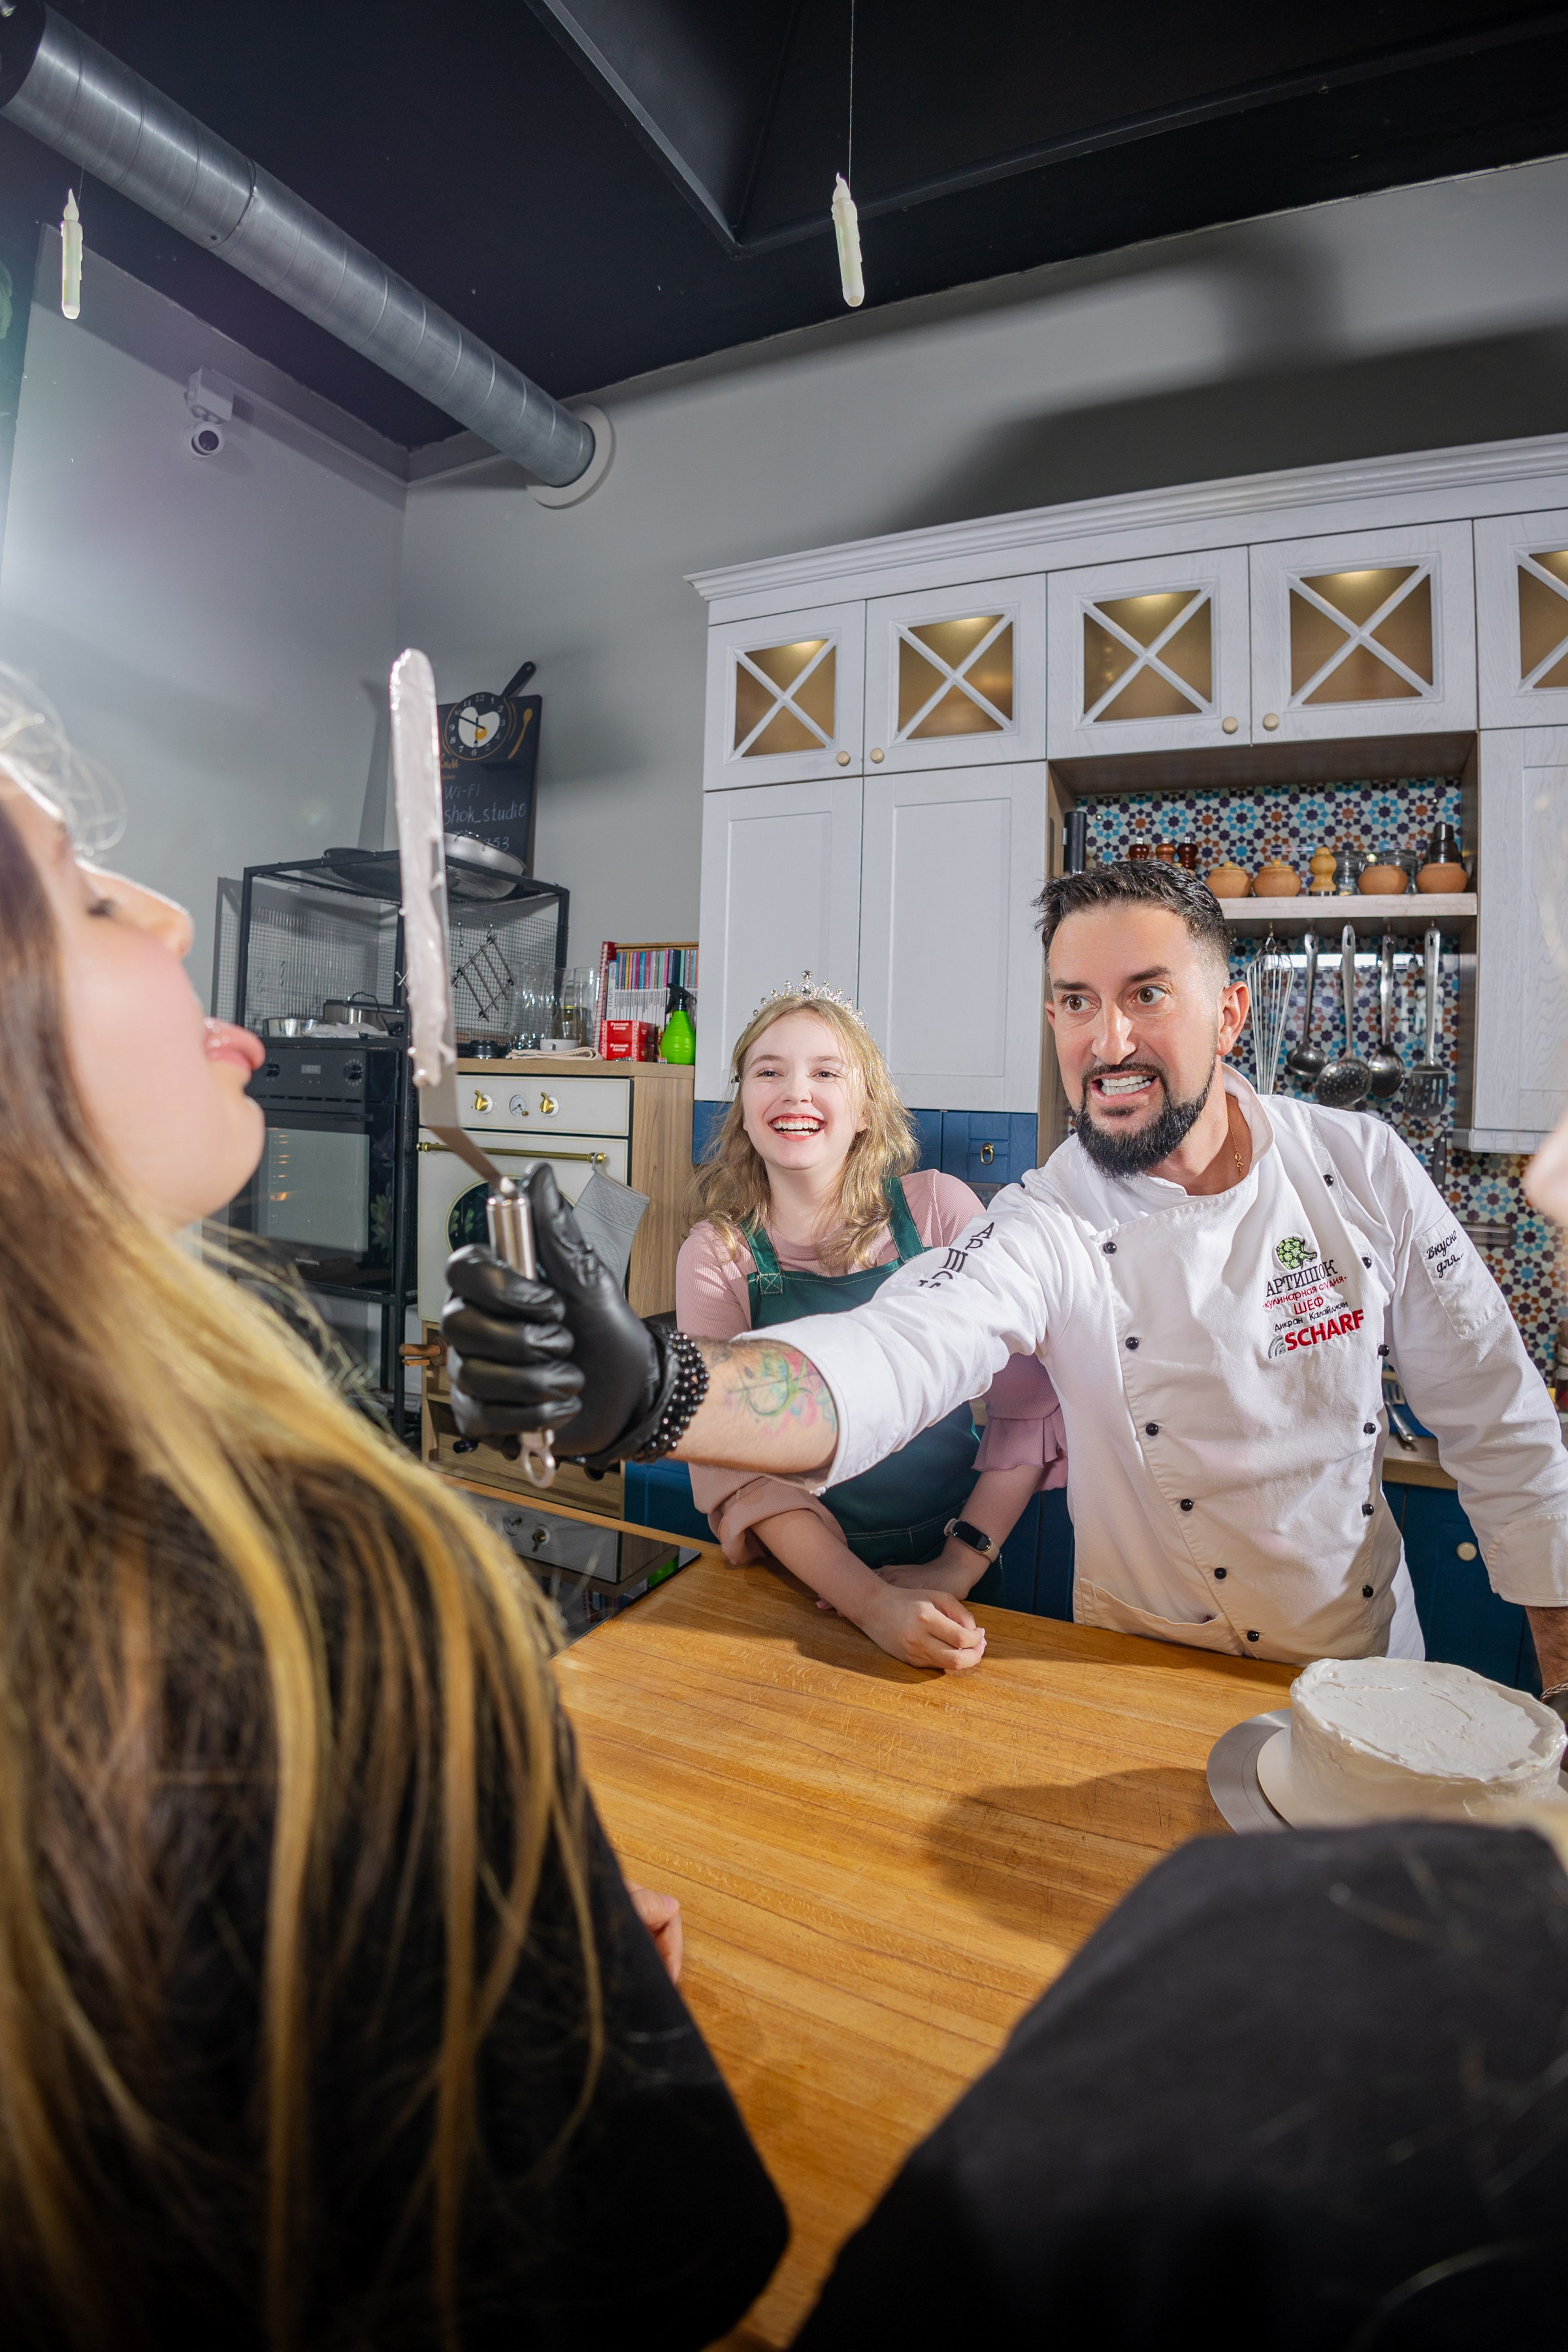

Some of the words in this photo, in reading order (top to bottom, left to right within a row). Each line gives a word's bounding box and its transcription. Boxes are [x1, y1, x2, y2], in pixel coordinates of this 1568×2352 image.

[1266, 1259, 1338, 1298] АРТИШОК
[1264, 1286, 1317, 1309] кулинарная
[1293, 1296, 1324, 1315] ШЕФ
[1274, 1317, 1303, 1333] Дикран
[1309, 1301, 1348, 1321] Калайджян
[1284, 1309, 1364, 1351] SCHARF
